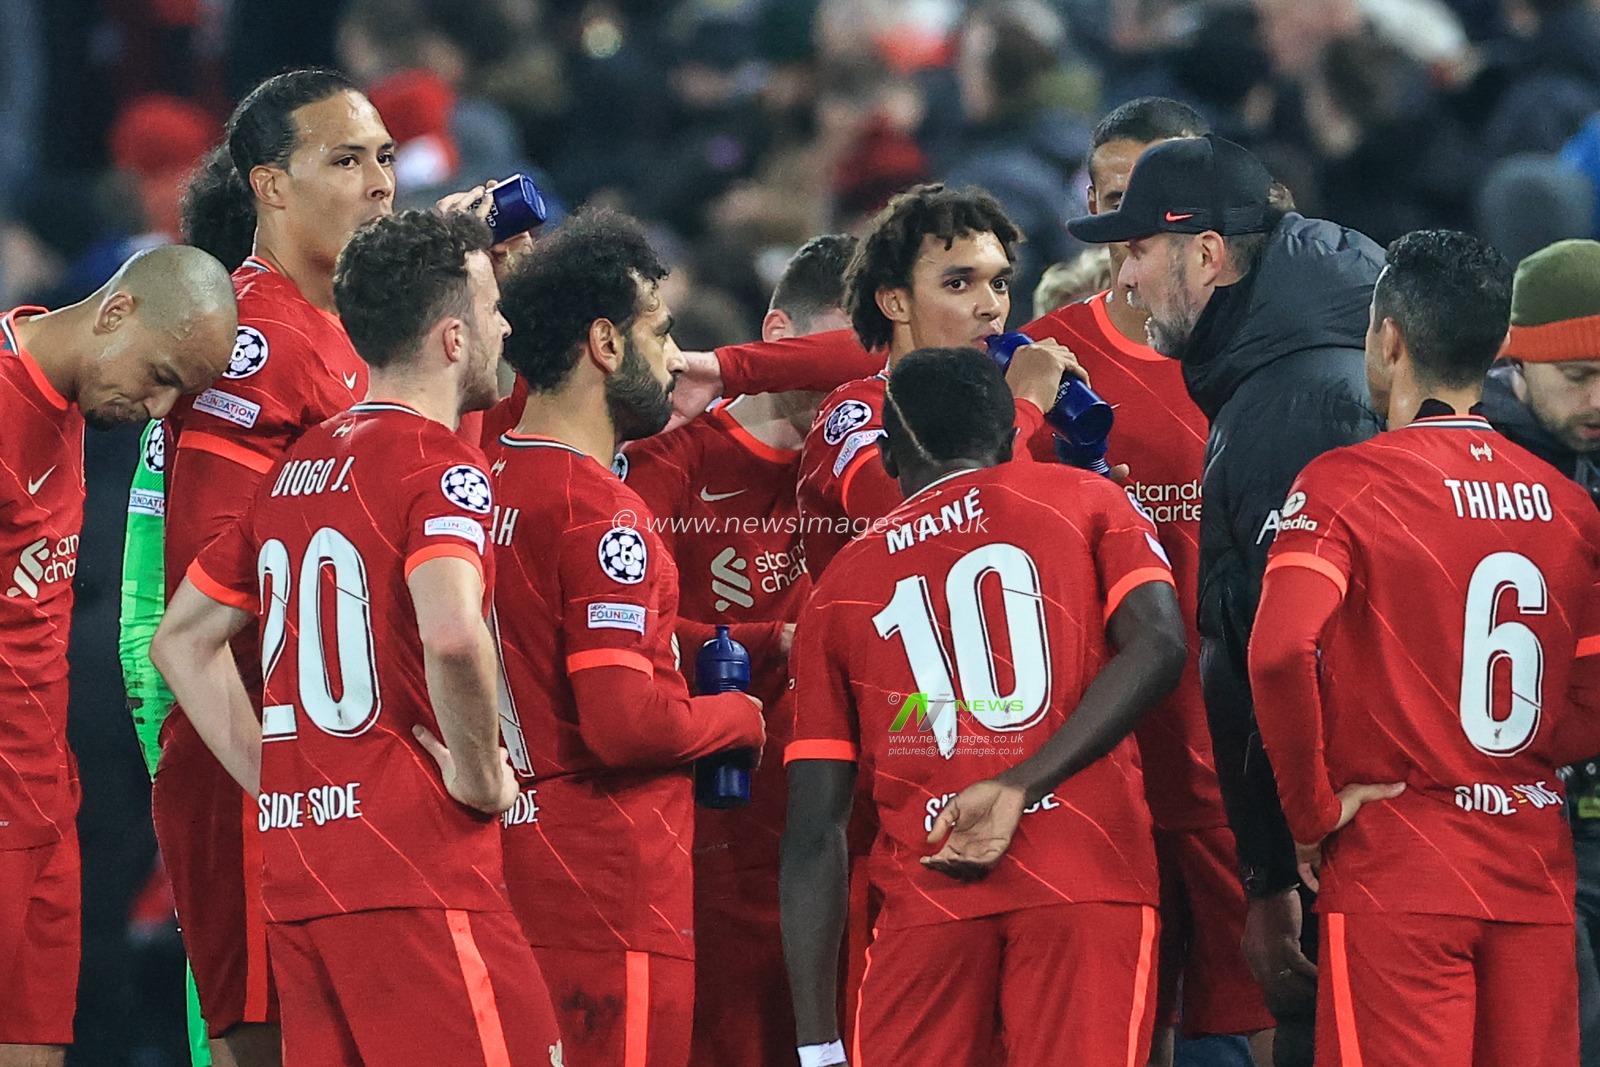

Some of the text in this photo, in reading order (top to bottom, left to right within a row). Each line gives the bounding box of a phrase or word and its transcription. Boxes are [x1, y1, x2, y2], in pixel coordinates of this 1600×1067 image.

[271, 456, 355, 498] DIOGO J.
[1444, 479, 1553, 522] THIAGO
[885, 487, 984, 556] MANÉ
[257, 527, 382, 743] 20
[871, 543, 1052, 760] 10
[1459, 551, 1548, 758] 6
[257, 791, 305, 833] SIDE
[307, 782, 363, 827] SIDE
